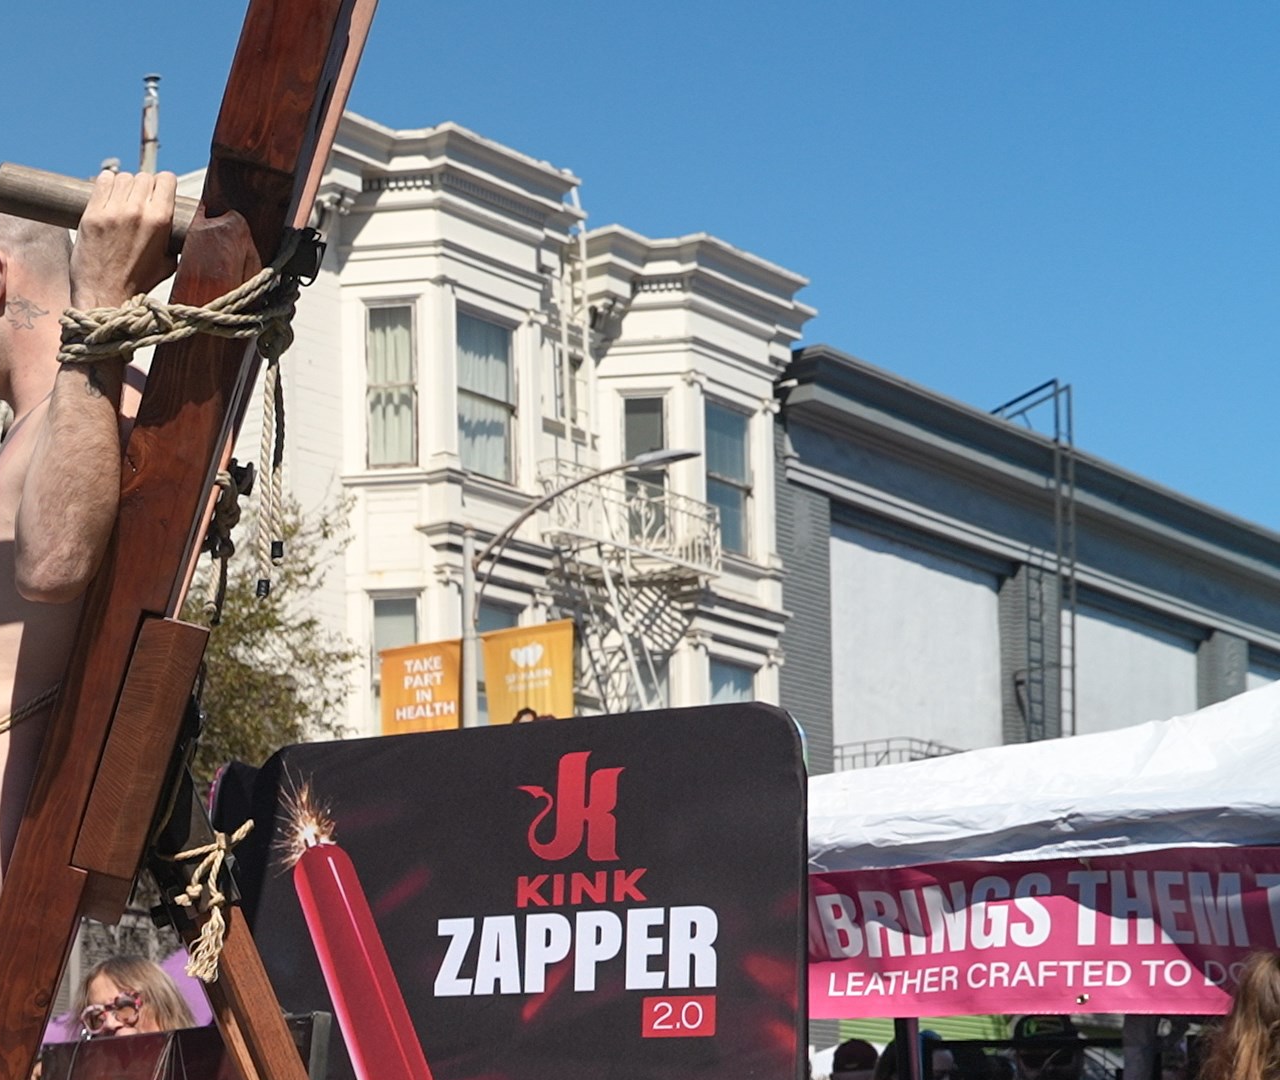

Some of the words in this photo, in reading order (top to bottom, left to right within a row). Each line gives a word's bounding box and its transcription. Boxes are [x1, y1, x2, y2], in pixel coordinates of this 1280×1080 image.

[403, 656, 443, 674] TAKE
[403, 672, 445, 690] PART
[415, 689, 432, 703] IN
[395, 701, 456, 721] HEALTH
[516, 867, 648, 908] KINK
[815, 875, 1052, 960] BRINGS
[1065, 869, 1250, 947] THEM
[433, 905, 719, 997] ZAPPER
[827, 962, 959, 997] LEATHER
[966, 960, 1132, 990] CRAFTED
[1141, 959, 1192, 988] TO
[651, 1001, 704, 1030] 2.0
